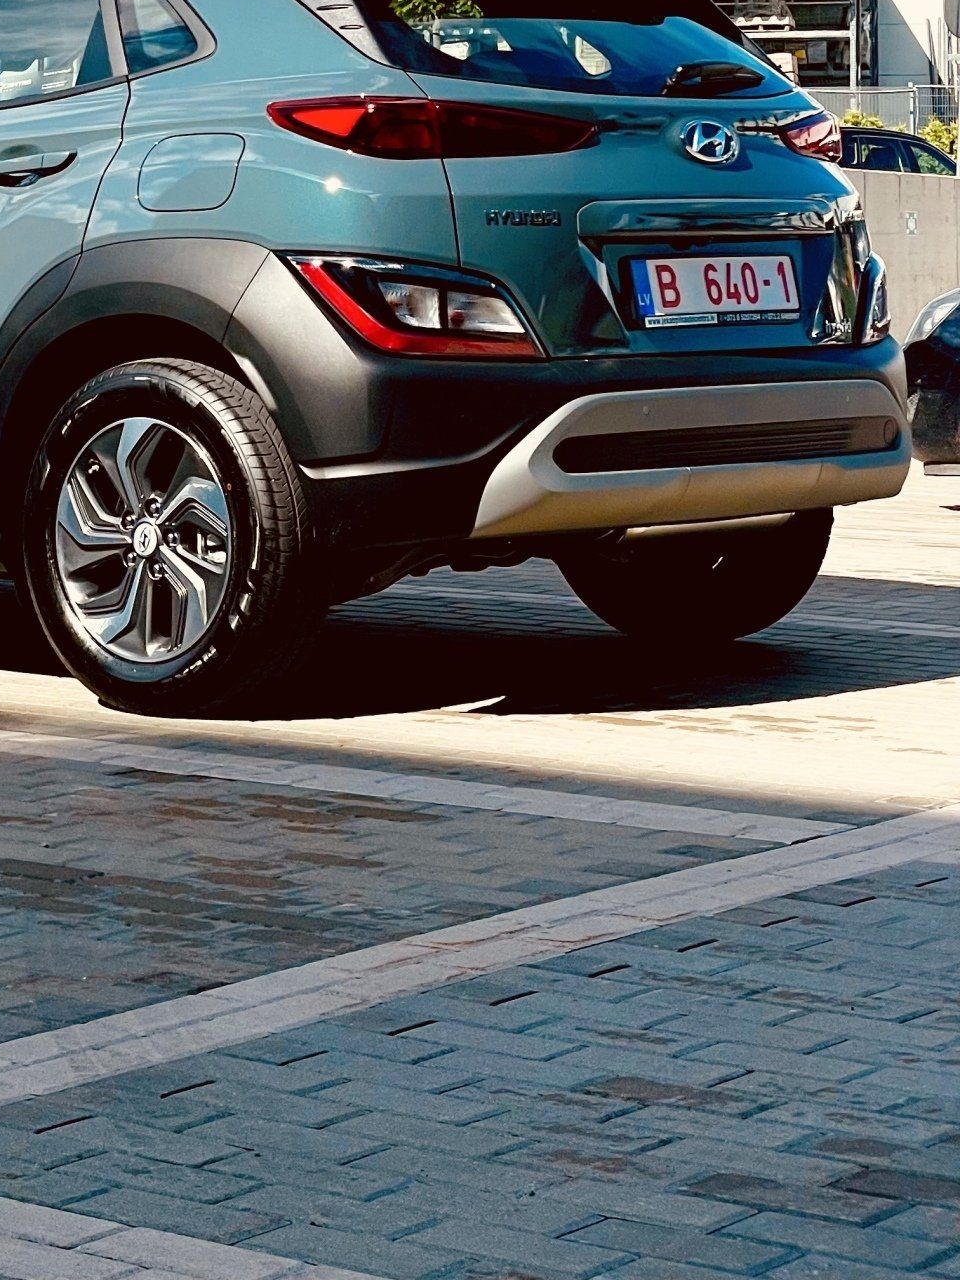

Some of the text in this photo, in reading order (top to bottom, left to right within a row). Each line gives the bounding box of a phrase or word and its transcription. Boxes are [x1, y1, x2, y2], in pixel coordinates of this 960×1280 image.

[637, 292, 651, 306] LV
[655, 261, 791, 309] B 640-1
